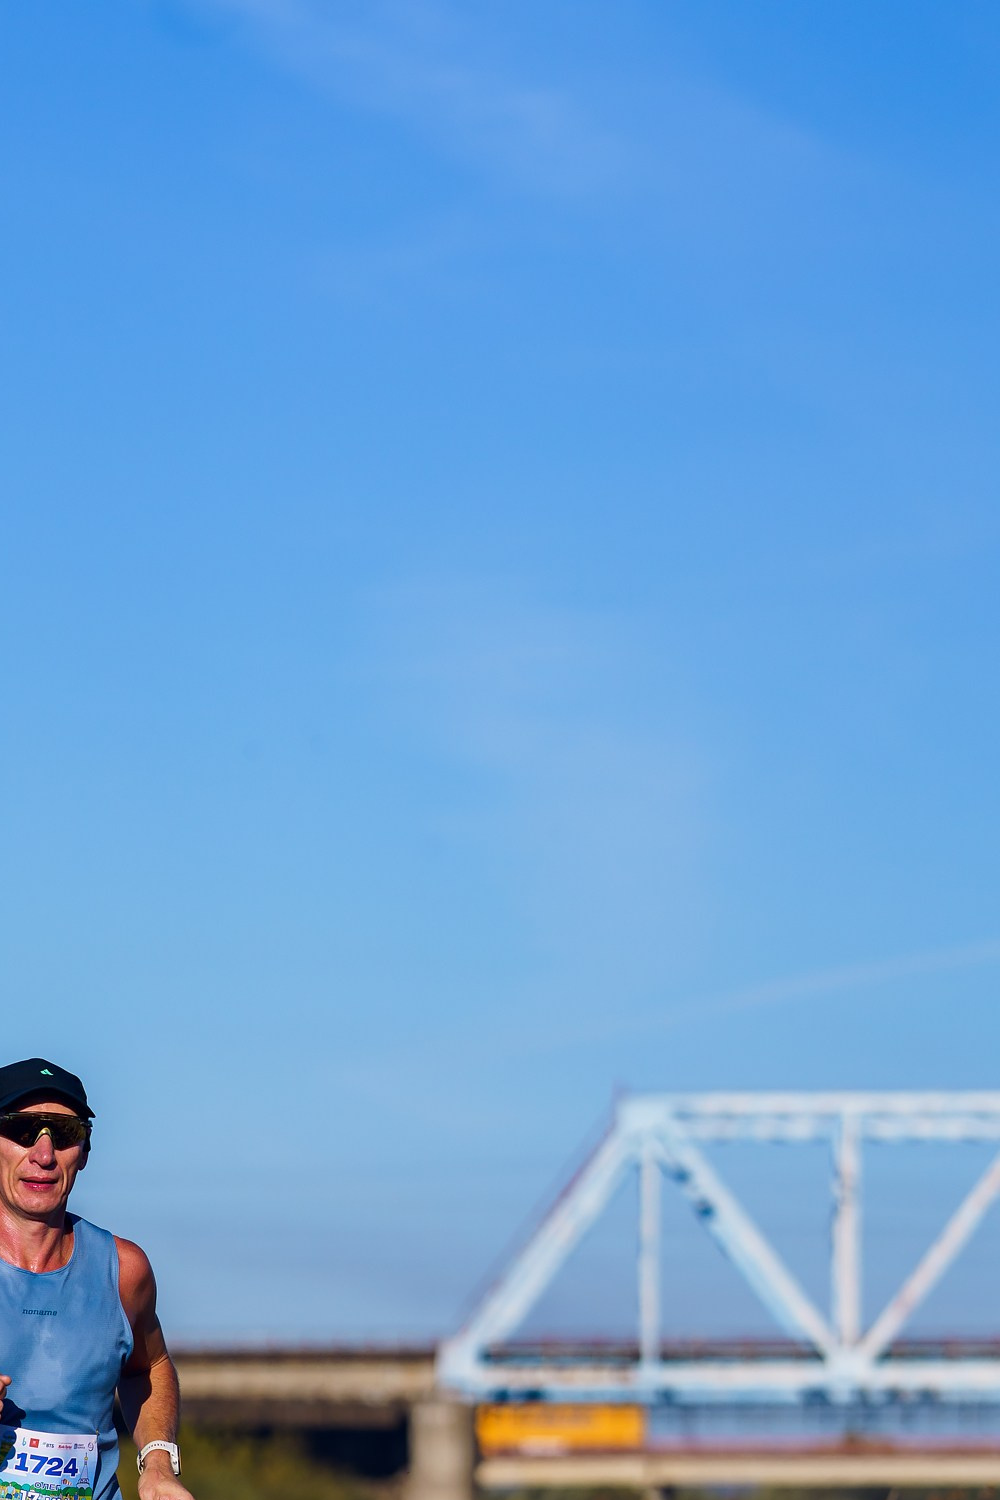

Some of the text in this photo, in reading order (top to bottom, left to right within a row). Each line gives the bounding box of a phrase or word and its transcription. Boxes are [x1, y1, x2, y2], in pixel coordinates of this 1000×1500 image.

[22, 1308, 58, 1317] noname
[14, 1452, 79, 1477] 1724
[35, 1481, 61, 1491] ОЛЕГ
